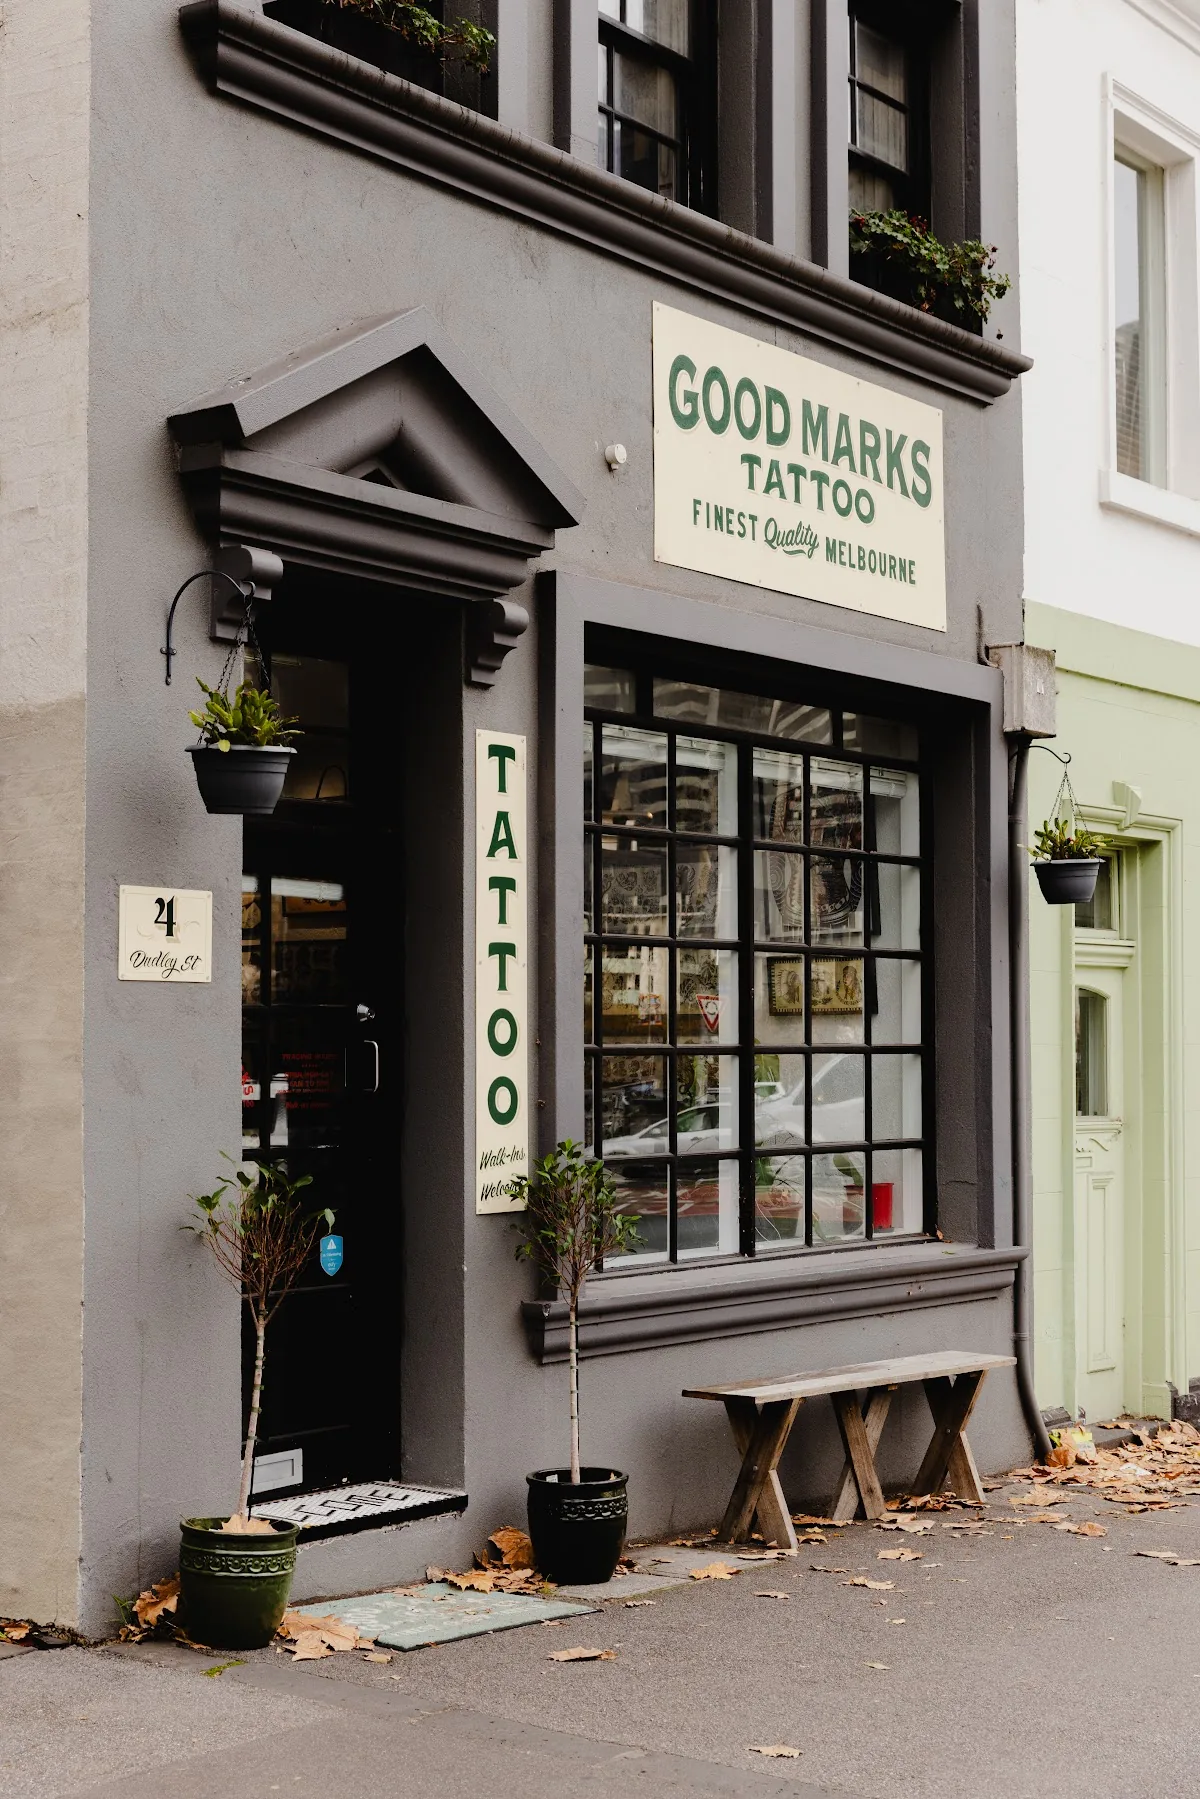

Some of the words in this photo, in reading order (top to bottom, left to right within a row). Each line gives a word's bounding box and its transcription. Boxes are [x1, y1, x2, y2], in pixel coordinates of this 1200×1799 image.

[668, 354, 791, 447] GOOD
[802, 398, 932, 509] MARKS
[740, 453, 875, 524] TATTOO
[692, 498, 758, 541] FINEST
[764, 517, 819, 559] Quality
[825, 536, 917, 585] MELBOURNE
[154, 895, 177, 938] 4
[486, 743, 518, 1126] TATTOO
[129, 949, 180, 979] Dudley
[480, 1179, 524, 1201] Welcom
